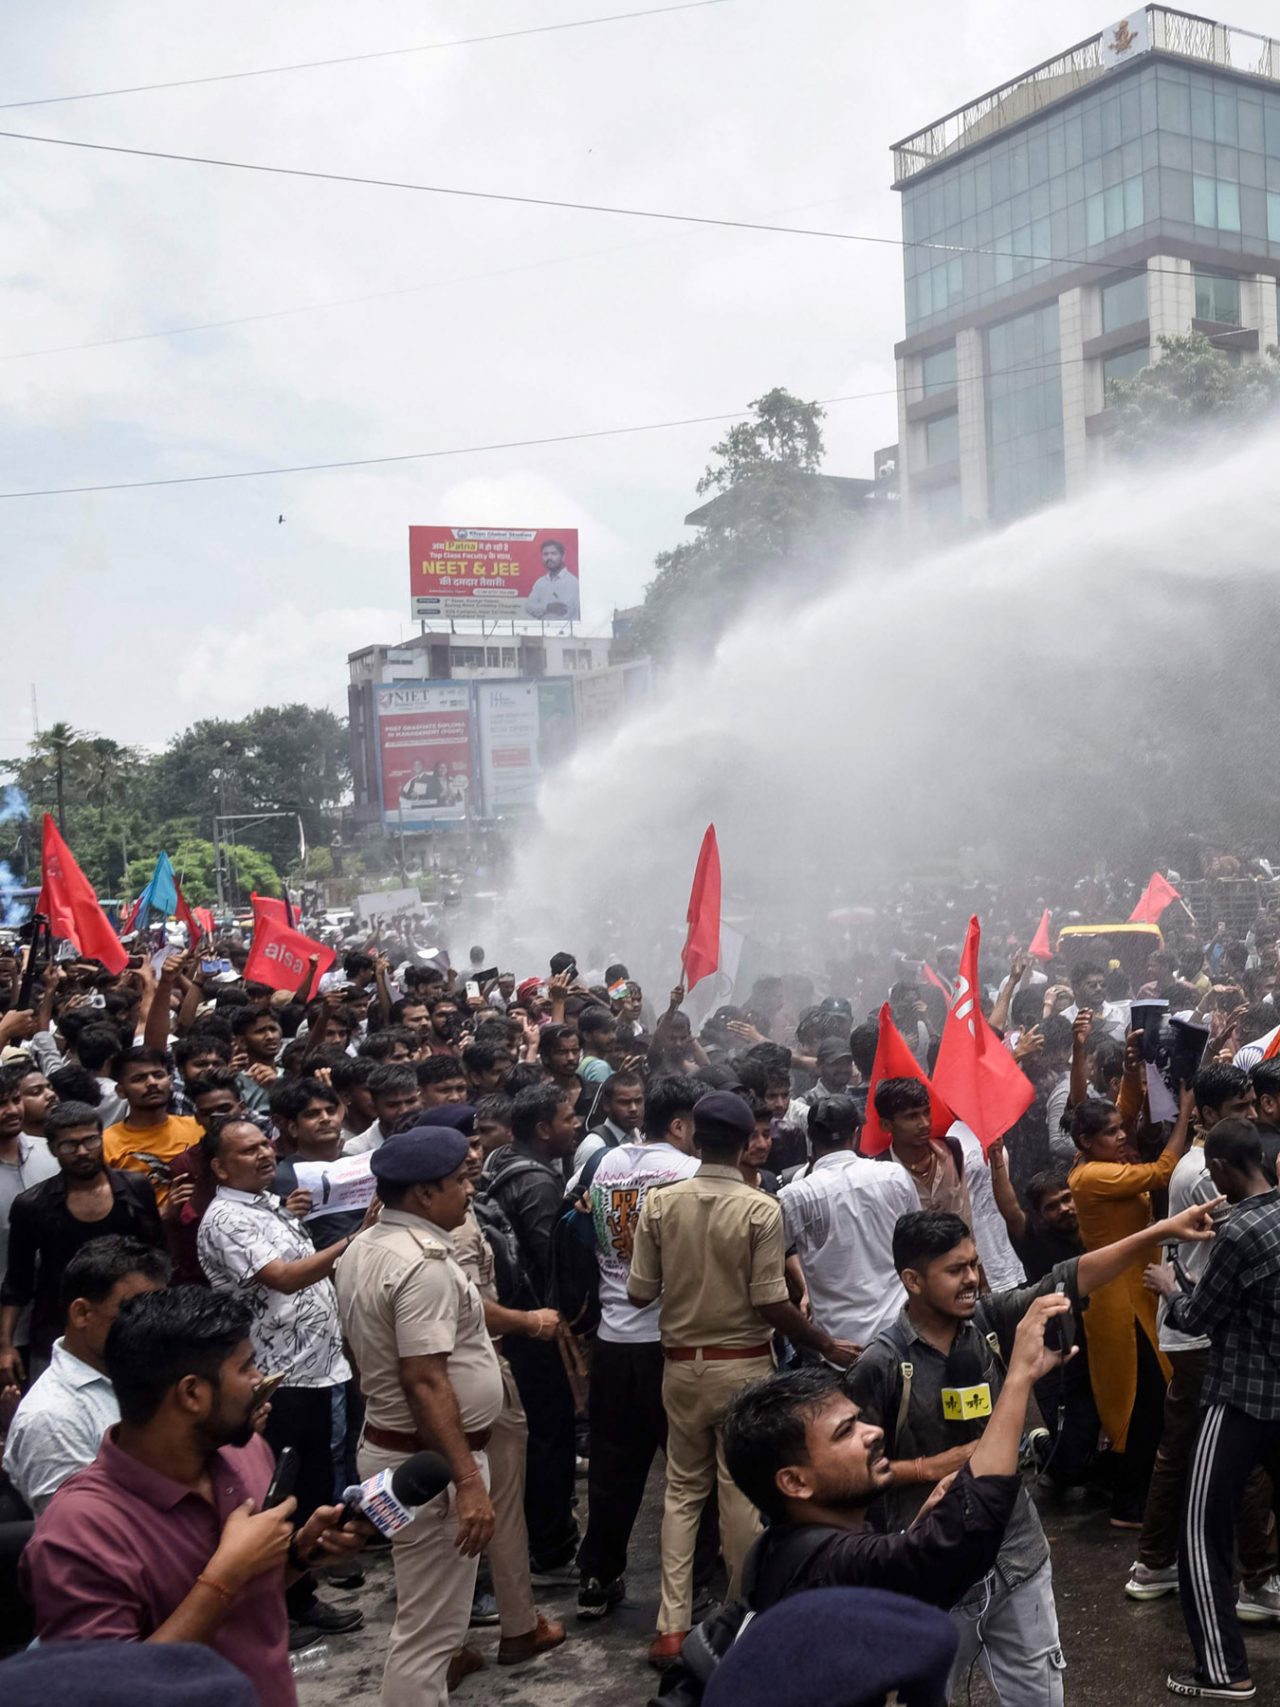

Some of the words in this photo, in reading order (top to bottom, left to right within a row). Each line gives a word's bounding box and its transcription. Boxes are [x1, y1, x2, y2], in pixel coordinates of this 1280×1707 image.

[422, 561, 468, 575] NEET
[473, 562, 487, 575] &
[491, 562, 520, 576] JEE
[365, 1505, 391, 1532] NEWS
[379, 1490, 411, 1522] PUBLIC
